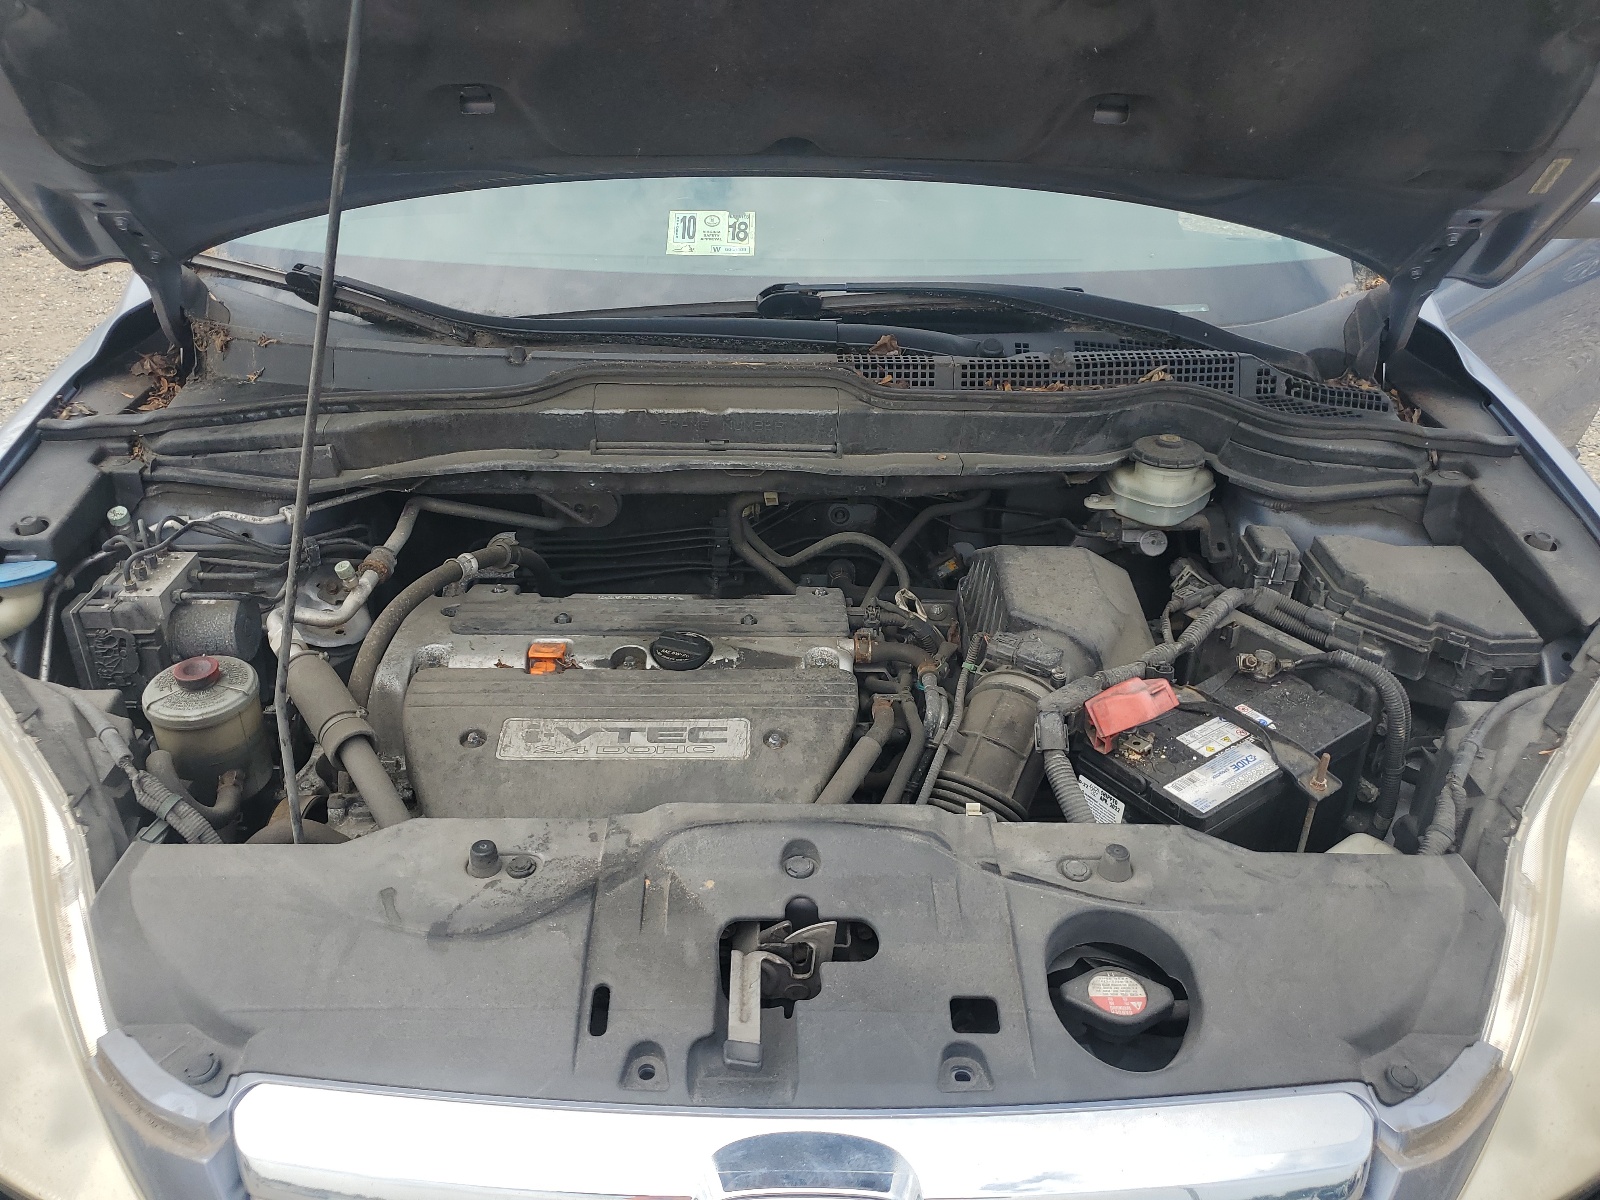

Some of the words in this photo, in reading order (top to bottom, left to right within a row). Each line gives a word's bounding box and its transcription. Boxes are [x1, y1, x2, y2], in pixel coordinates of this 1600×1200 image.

[680, 215, 697, 240] 10
[729, 221, 749, 242] 18
[722, 420, 784, 431] NUMBER
[533, 745, 587, 755] 2.4
[596, 745, 716, 755] DOHC
[1230, 754, 1257, 773] EXIDE
[1109, 802, 1121, 813] 2022
